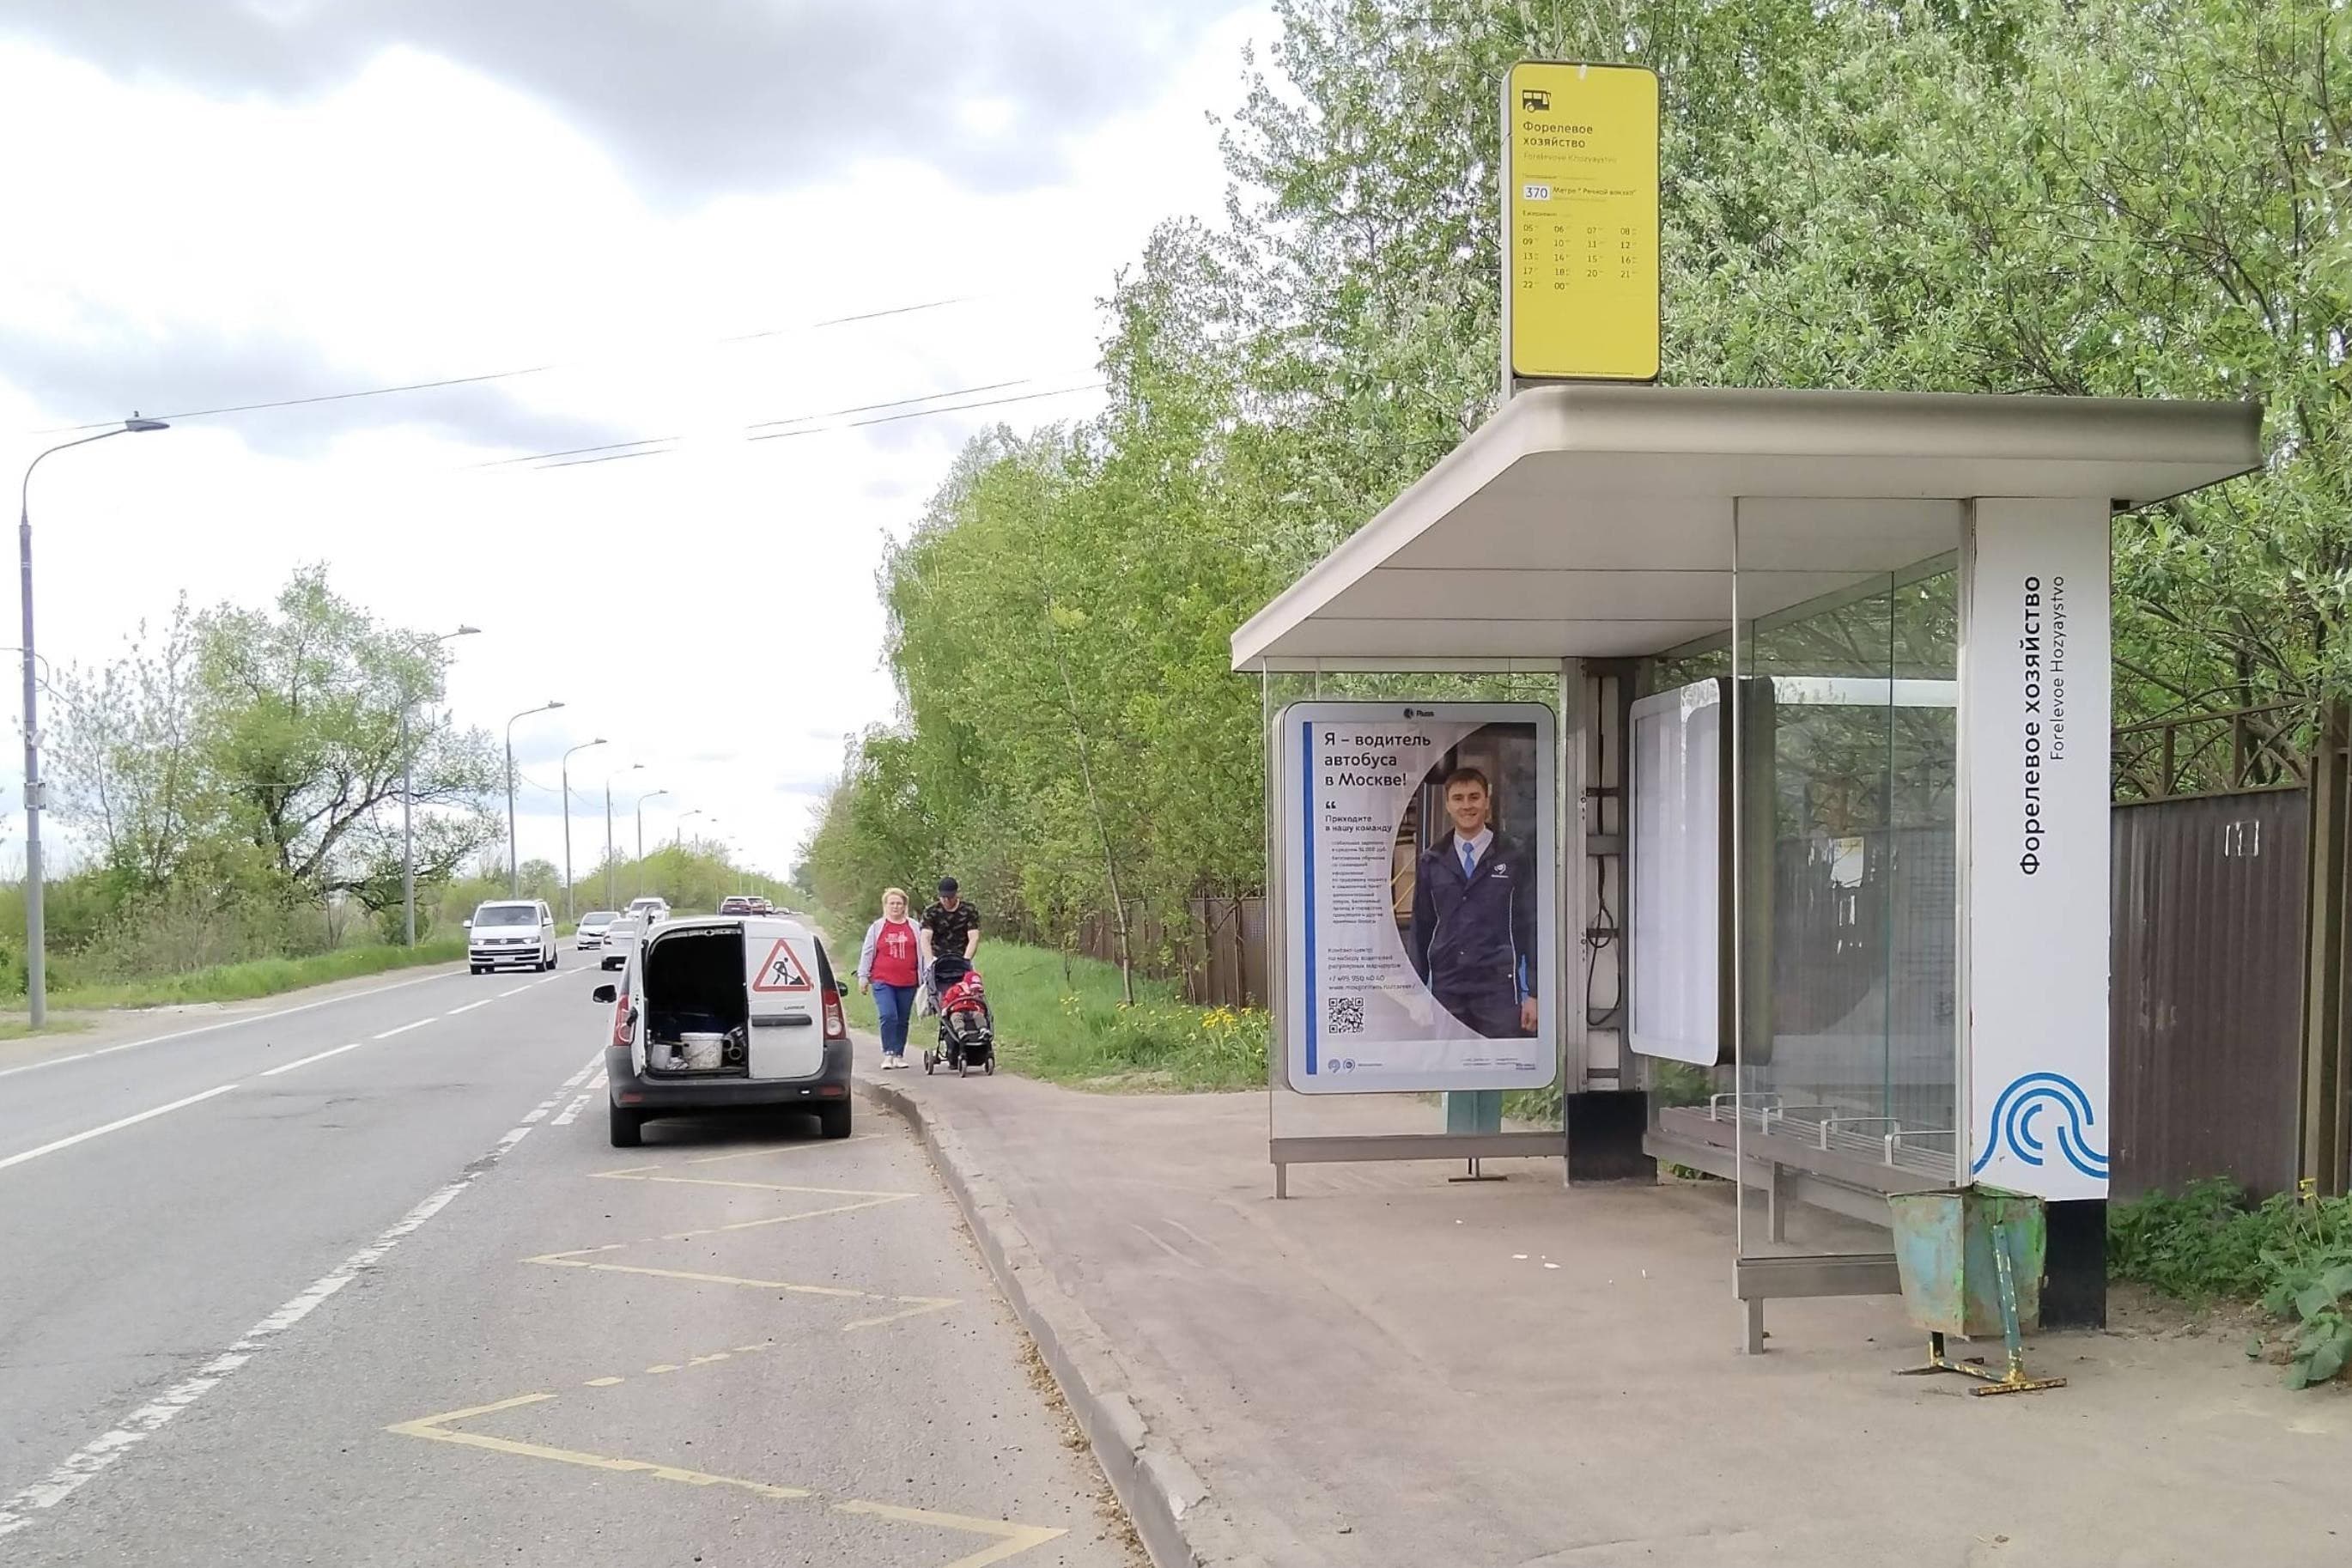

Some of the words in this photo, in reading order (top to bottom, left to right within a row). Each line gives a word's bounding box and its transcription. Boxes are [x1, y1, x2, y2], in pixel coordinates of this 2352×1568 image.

[1522, 121, 1593, 134] Форелевое
[1523, 137, 1585, 148] хозяйство
[1525, 187, 1547, 198] 370
[1621, 256, 1631, 264] 16
[2051, 576, 2067, 672] Hozyaystvo
[2020, 576, 2040, 714] хозяйство
[2050, 678, 2064, 760] Forelevoe
[1325, 732, 1335, 745] Я
[1355, 736, 1431, 748] водитель
[1325, 752, 1397, 769] автобуса
[1325, 776, 1334, 786] в
[1339, 773, 1407, 786] Москве!
[2020, 722, 2045, 875] Форелевое
